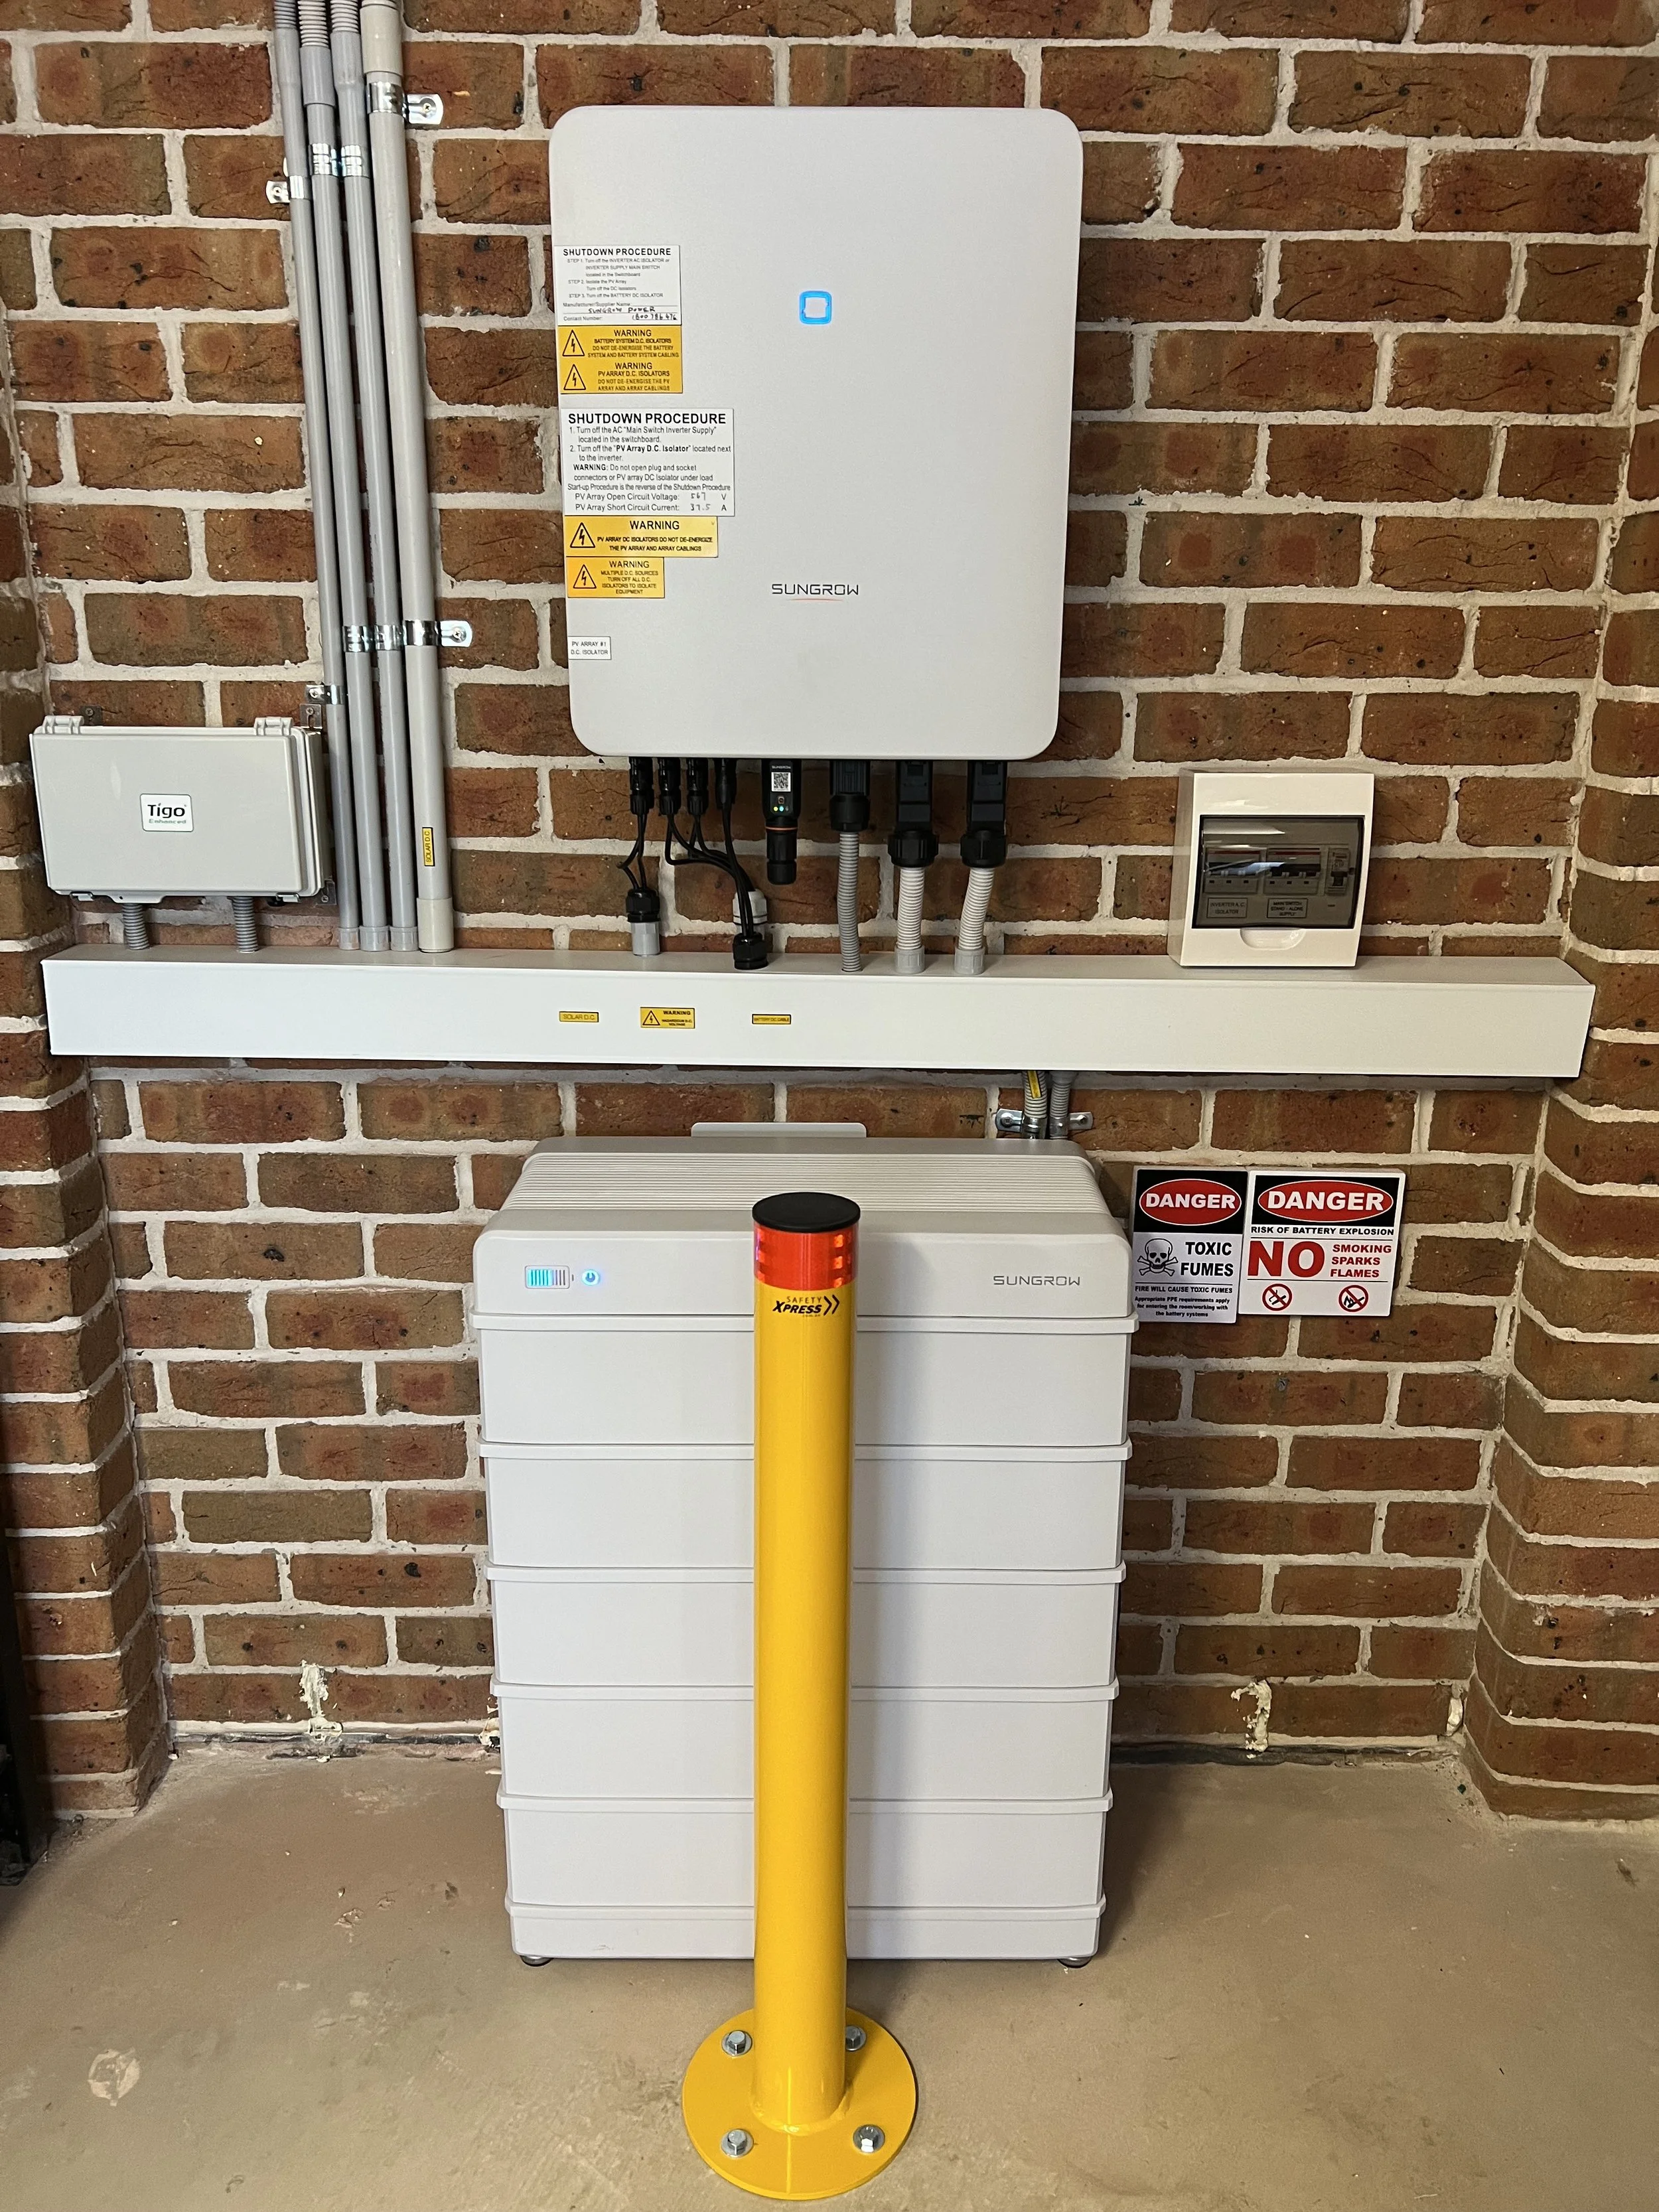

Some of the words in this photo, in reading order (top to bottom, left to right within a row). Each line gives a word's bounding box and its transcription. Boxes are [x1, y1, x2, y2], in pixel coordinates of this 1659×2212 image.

[568, 413, 642, 423] SHUTDOWN
[646, 413, 726, 423] PROCEDURE
[652, 493, 680, 502] Voltage:
[630, 521, 680, 530] WARNING
[771, 583, 859, 596] SUNGROW
[147, 803, 185, 818] Tigo
[1145, 1193, 1236, 1209] DANGER
[1267, 1191, 1384, 1211] DANGER
[1185, 1242, 1232, 1256] TOXIC
[1332, 1244, 1392, 1253] SMOKING
[1248, 1240, 1325, 1278] NO
[1181, 1263, 1234, 1276] FUMES
[1330, 1269, 1380, 1278] FLAMES
[993, 1276, 1080, 1286] SUNGROW
[786, 1295, 822, 1304] SAFETY
[772, 1301, 822, 1314] XPRESS
